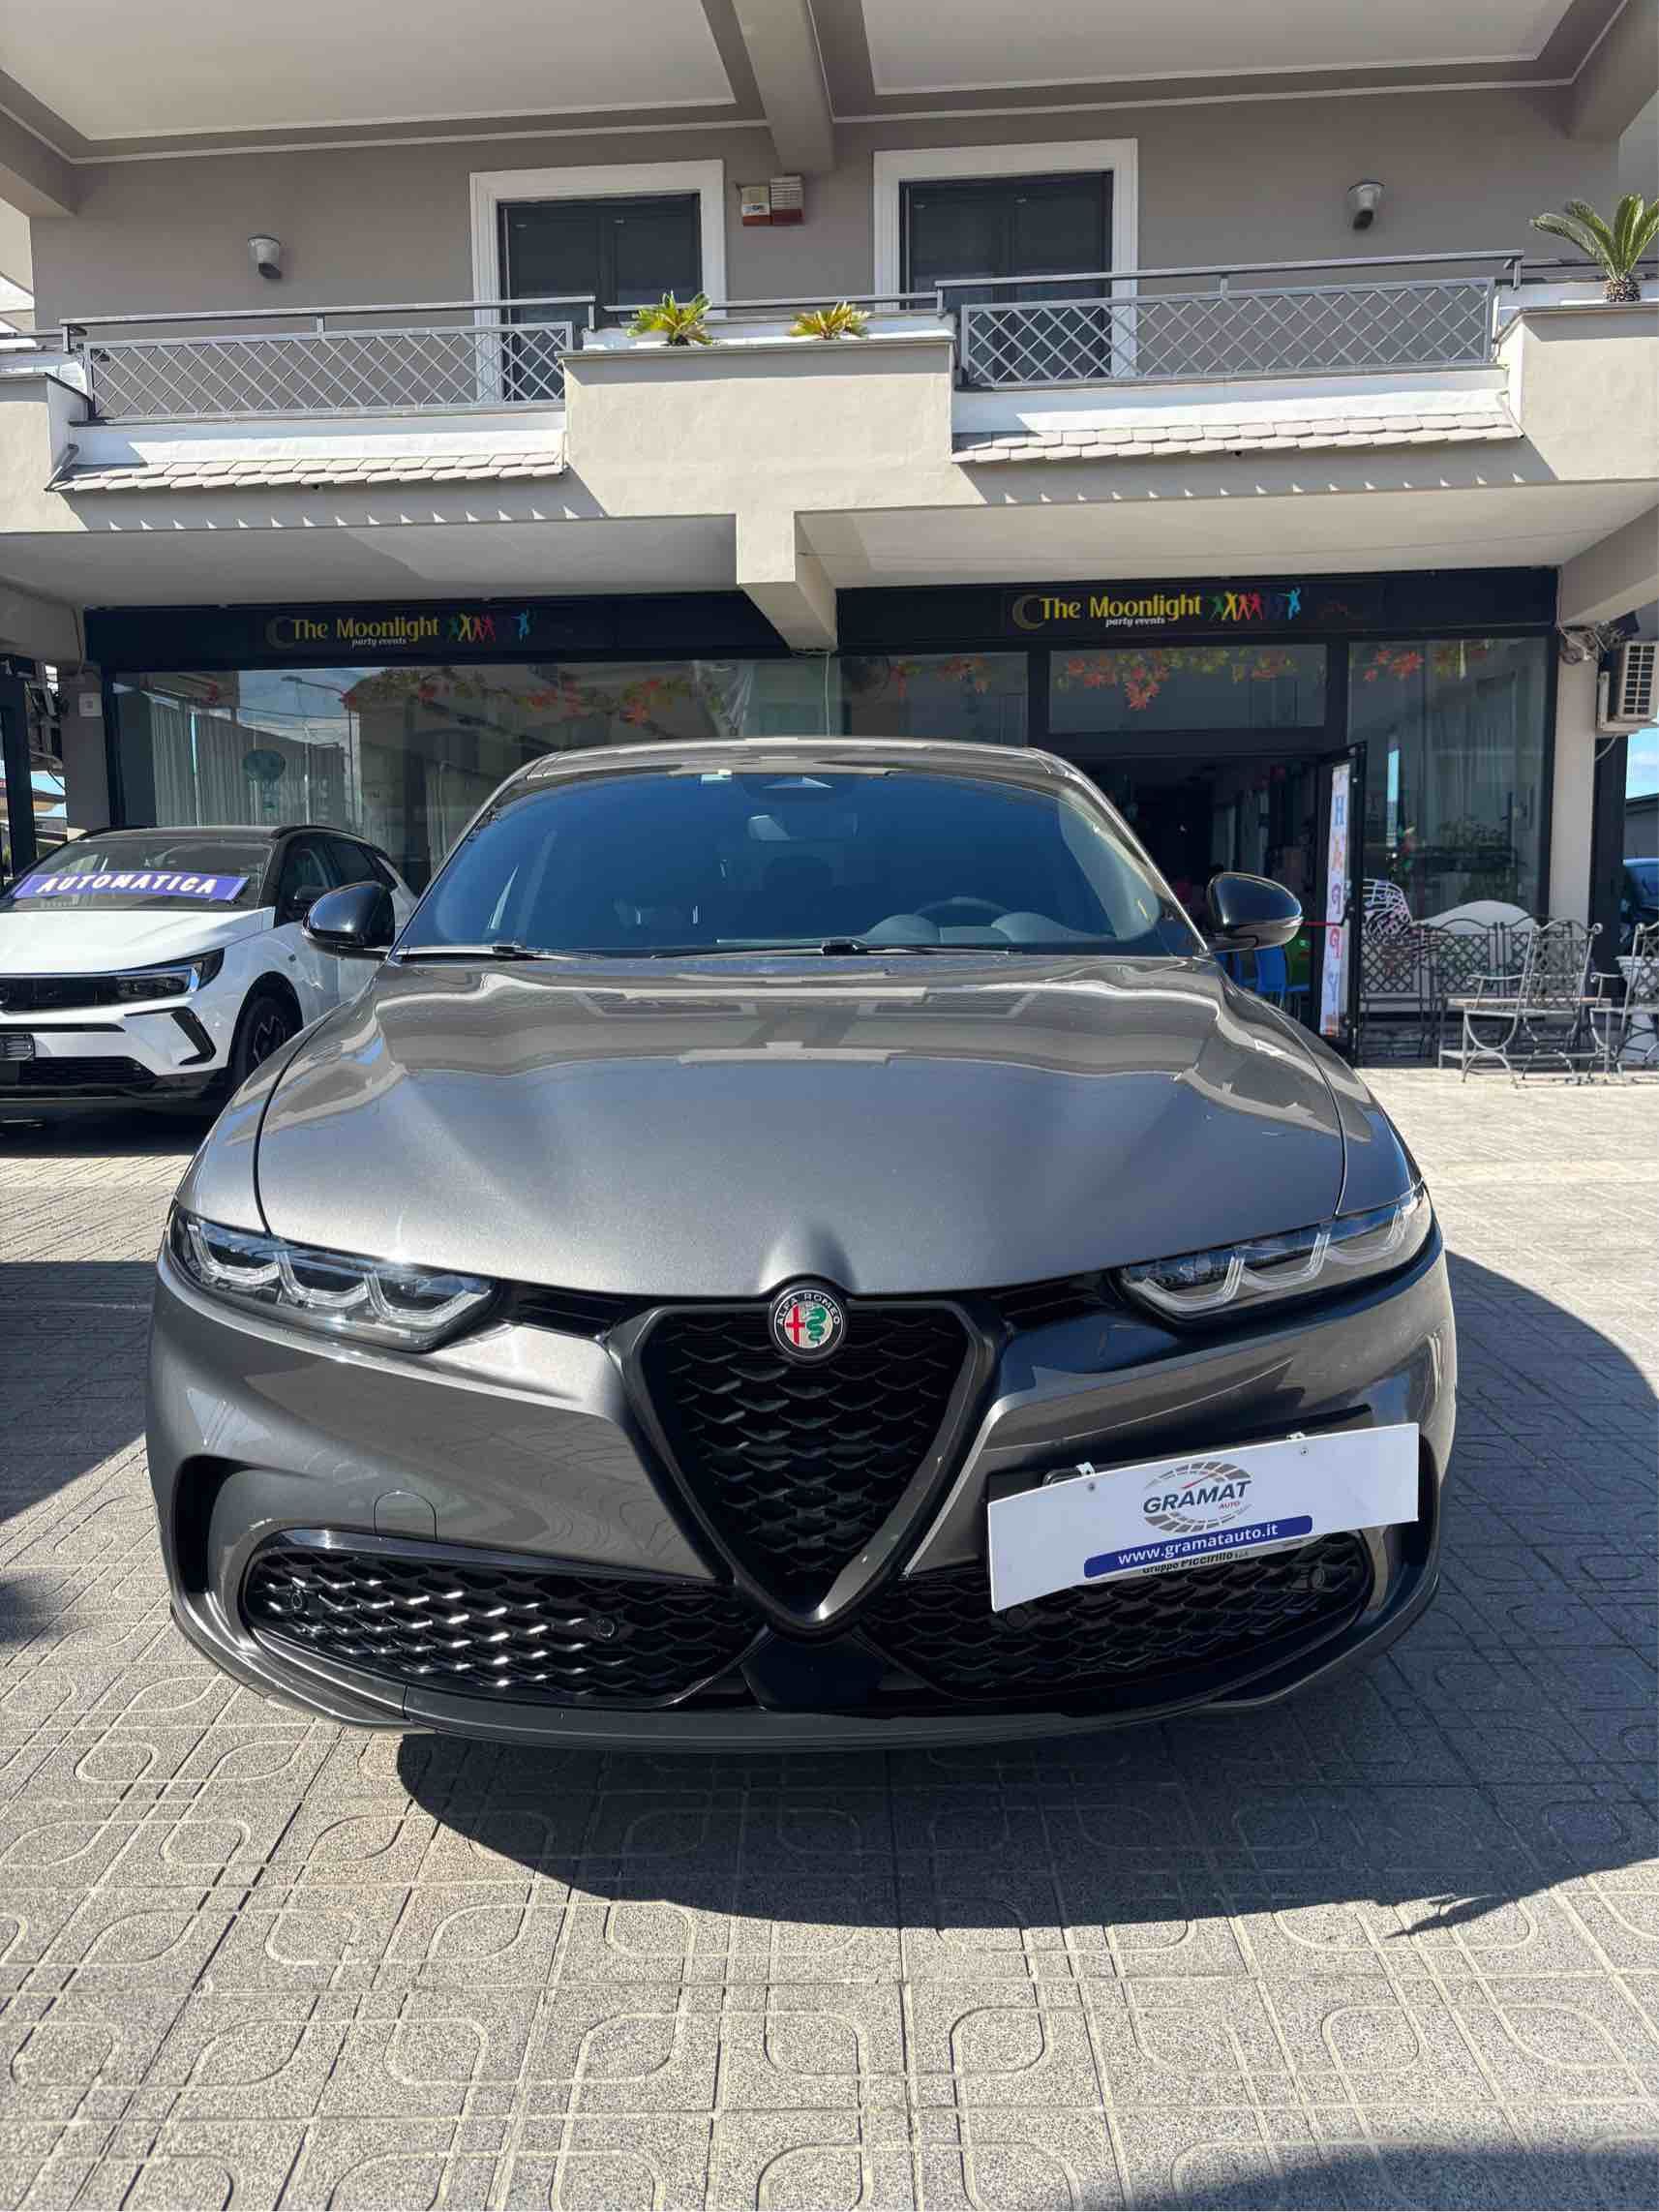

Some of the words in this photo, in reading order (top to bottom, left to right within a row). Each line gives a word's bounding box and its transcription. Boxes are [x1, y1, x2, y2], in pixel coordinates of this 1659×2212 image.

[1039, 595, 1081, 620] The
[1090, 592, 1202, 621] Moonlight
[292, 618, 330, 640] The
[337, 616, 440, 643] Moonlight
[1105, 616, 1132, 628] party
[1134, 615, 1166, 625] events
[351, 637, 377, 649] party
[36, 874, 218, 894] AUTOMATICA
[777, 1297, 799, 1325] ALFA
[803, 1292, 840, 1325] ROMEO
[1143, 1480, 1252, 1514] GRAMAT
[1219, 1500, 1241, 1510] AUTO
[1117, 1524, 1279, 1565] www.gramatauto.it
